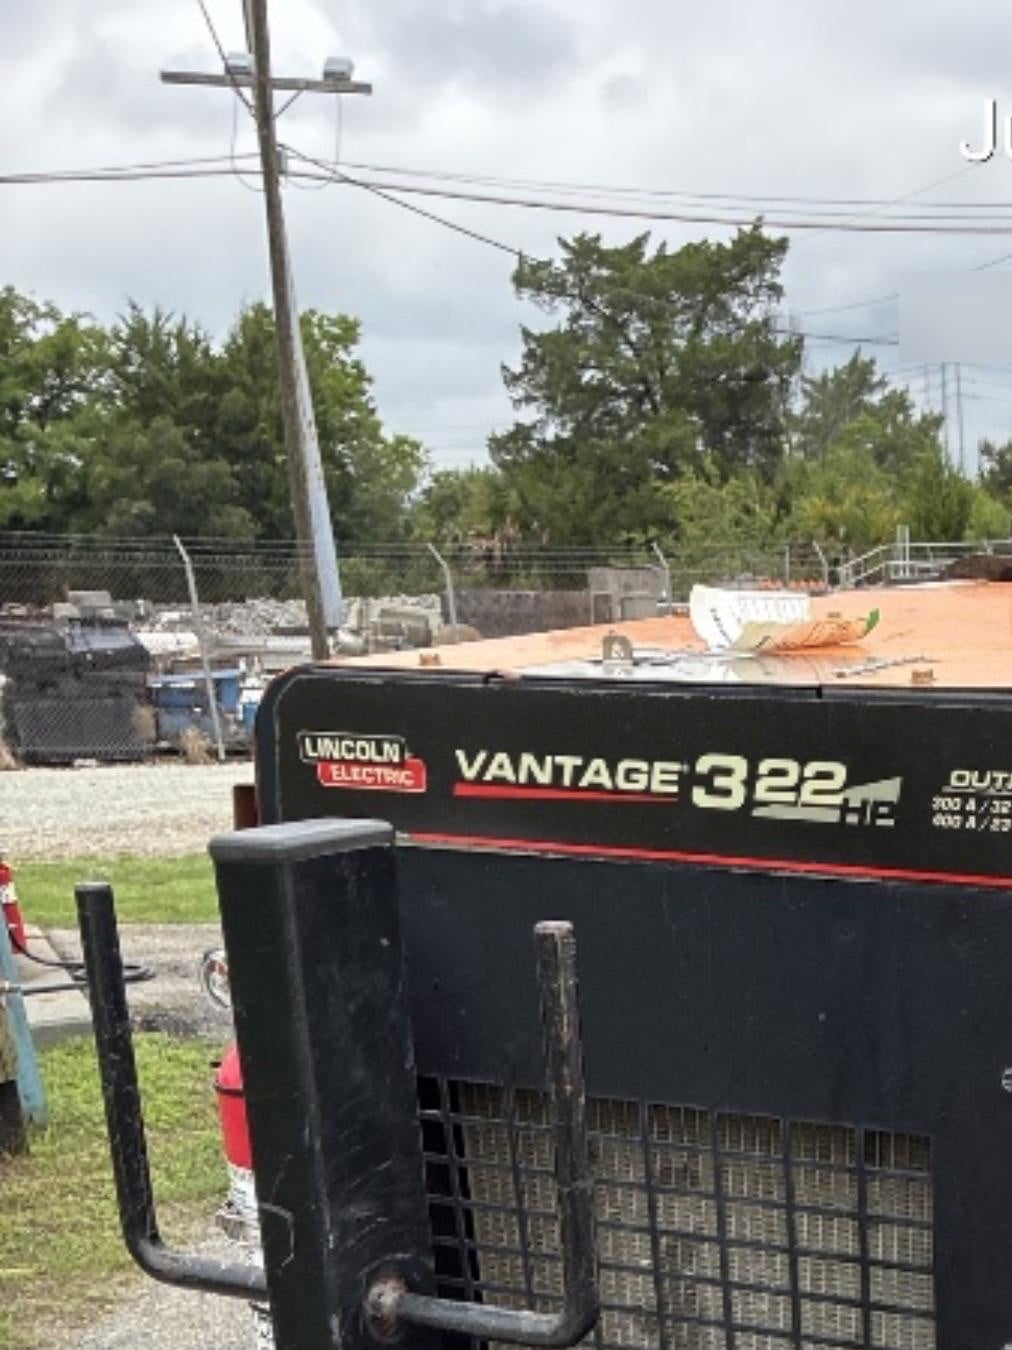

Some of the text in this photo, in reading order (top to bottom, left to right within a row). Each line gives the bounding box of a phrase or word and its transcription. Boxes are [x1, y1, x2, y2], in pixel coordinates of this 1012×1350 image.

[304, 736, 400, 763] LINCOLN
[329, 765, 415, 787] ELECTRIC
[455, 749, 681, 793] VANTAGE
[692, 753, 847, 812] 322
